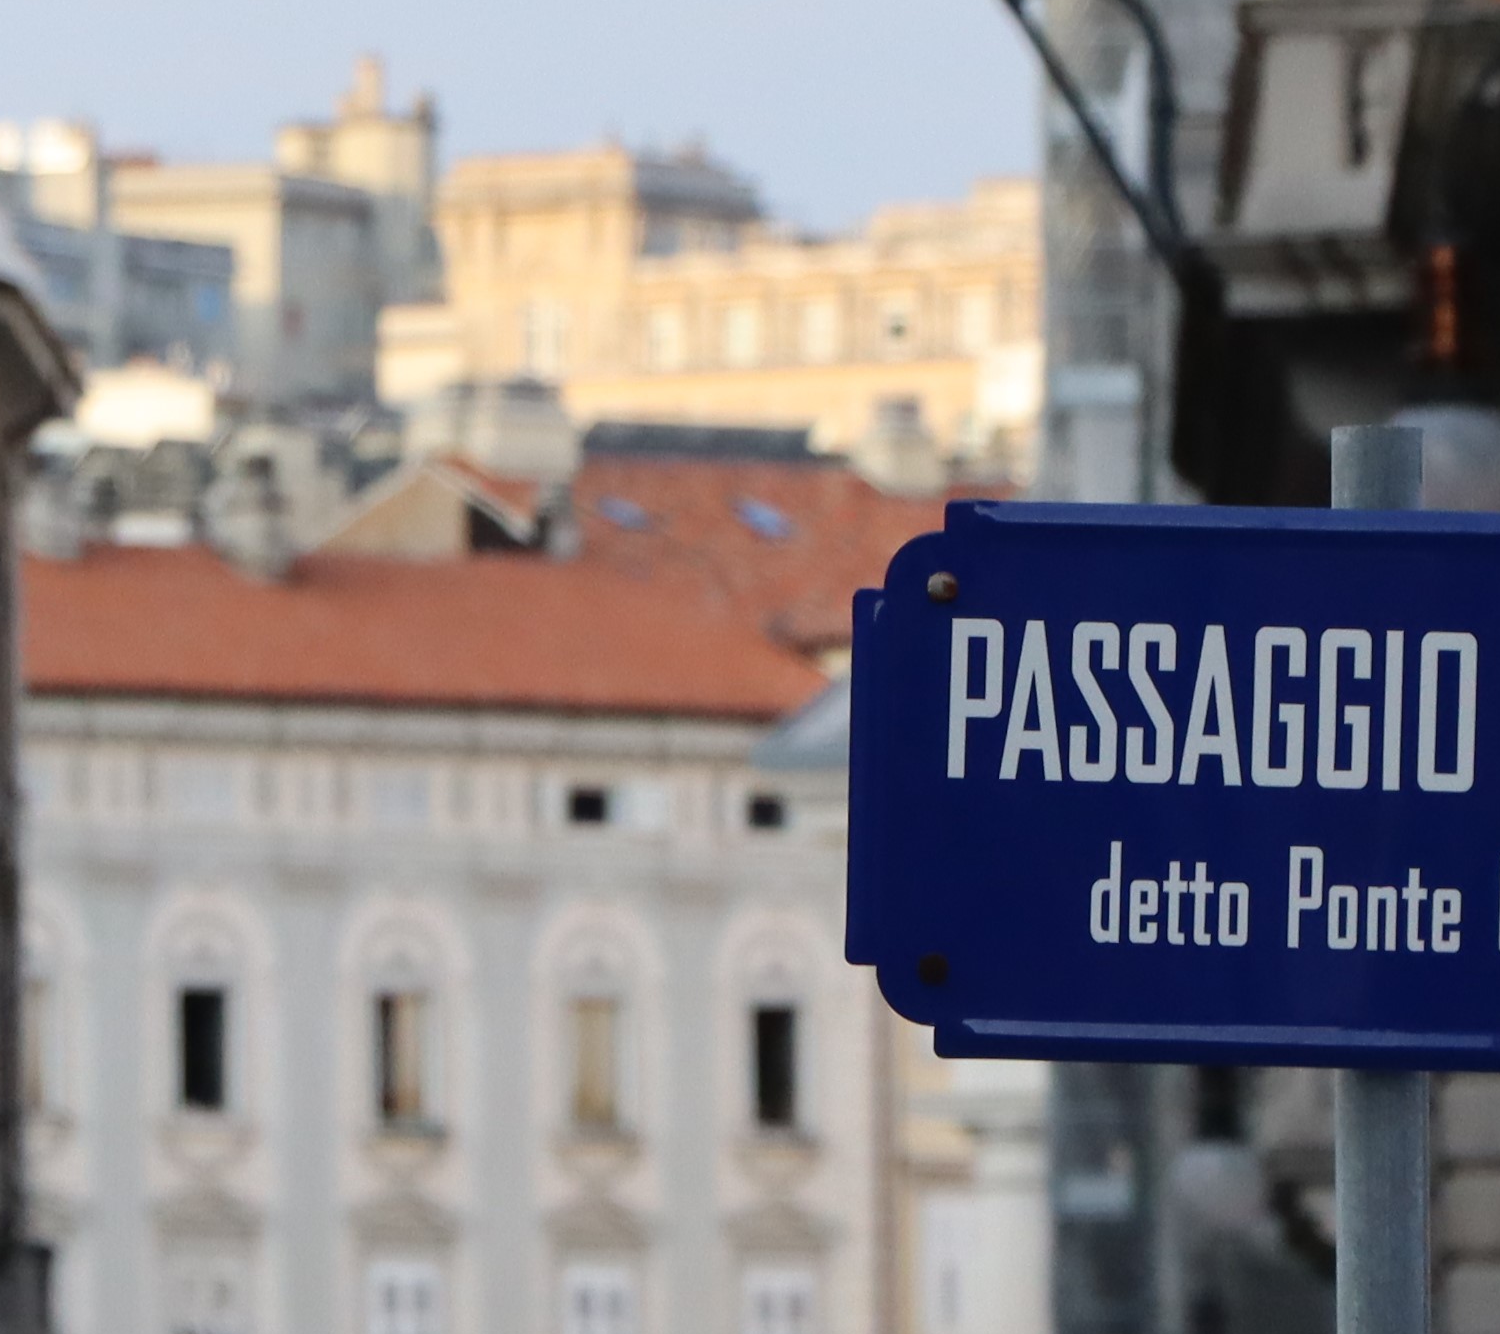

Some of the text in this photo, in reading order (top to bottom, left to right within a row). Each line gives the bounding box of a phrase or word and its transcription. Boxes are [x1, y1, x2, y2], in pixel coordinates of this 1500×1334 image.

[947, 618, 1478, 792] PASSAGGIO
[1090, 841, 1249, 946] detto
[1287, 846, 1461, 952] Ponte
